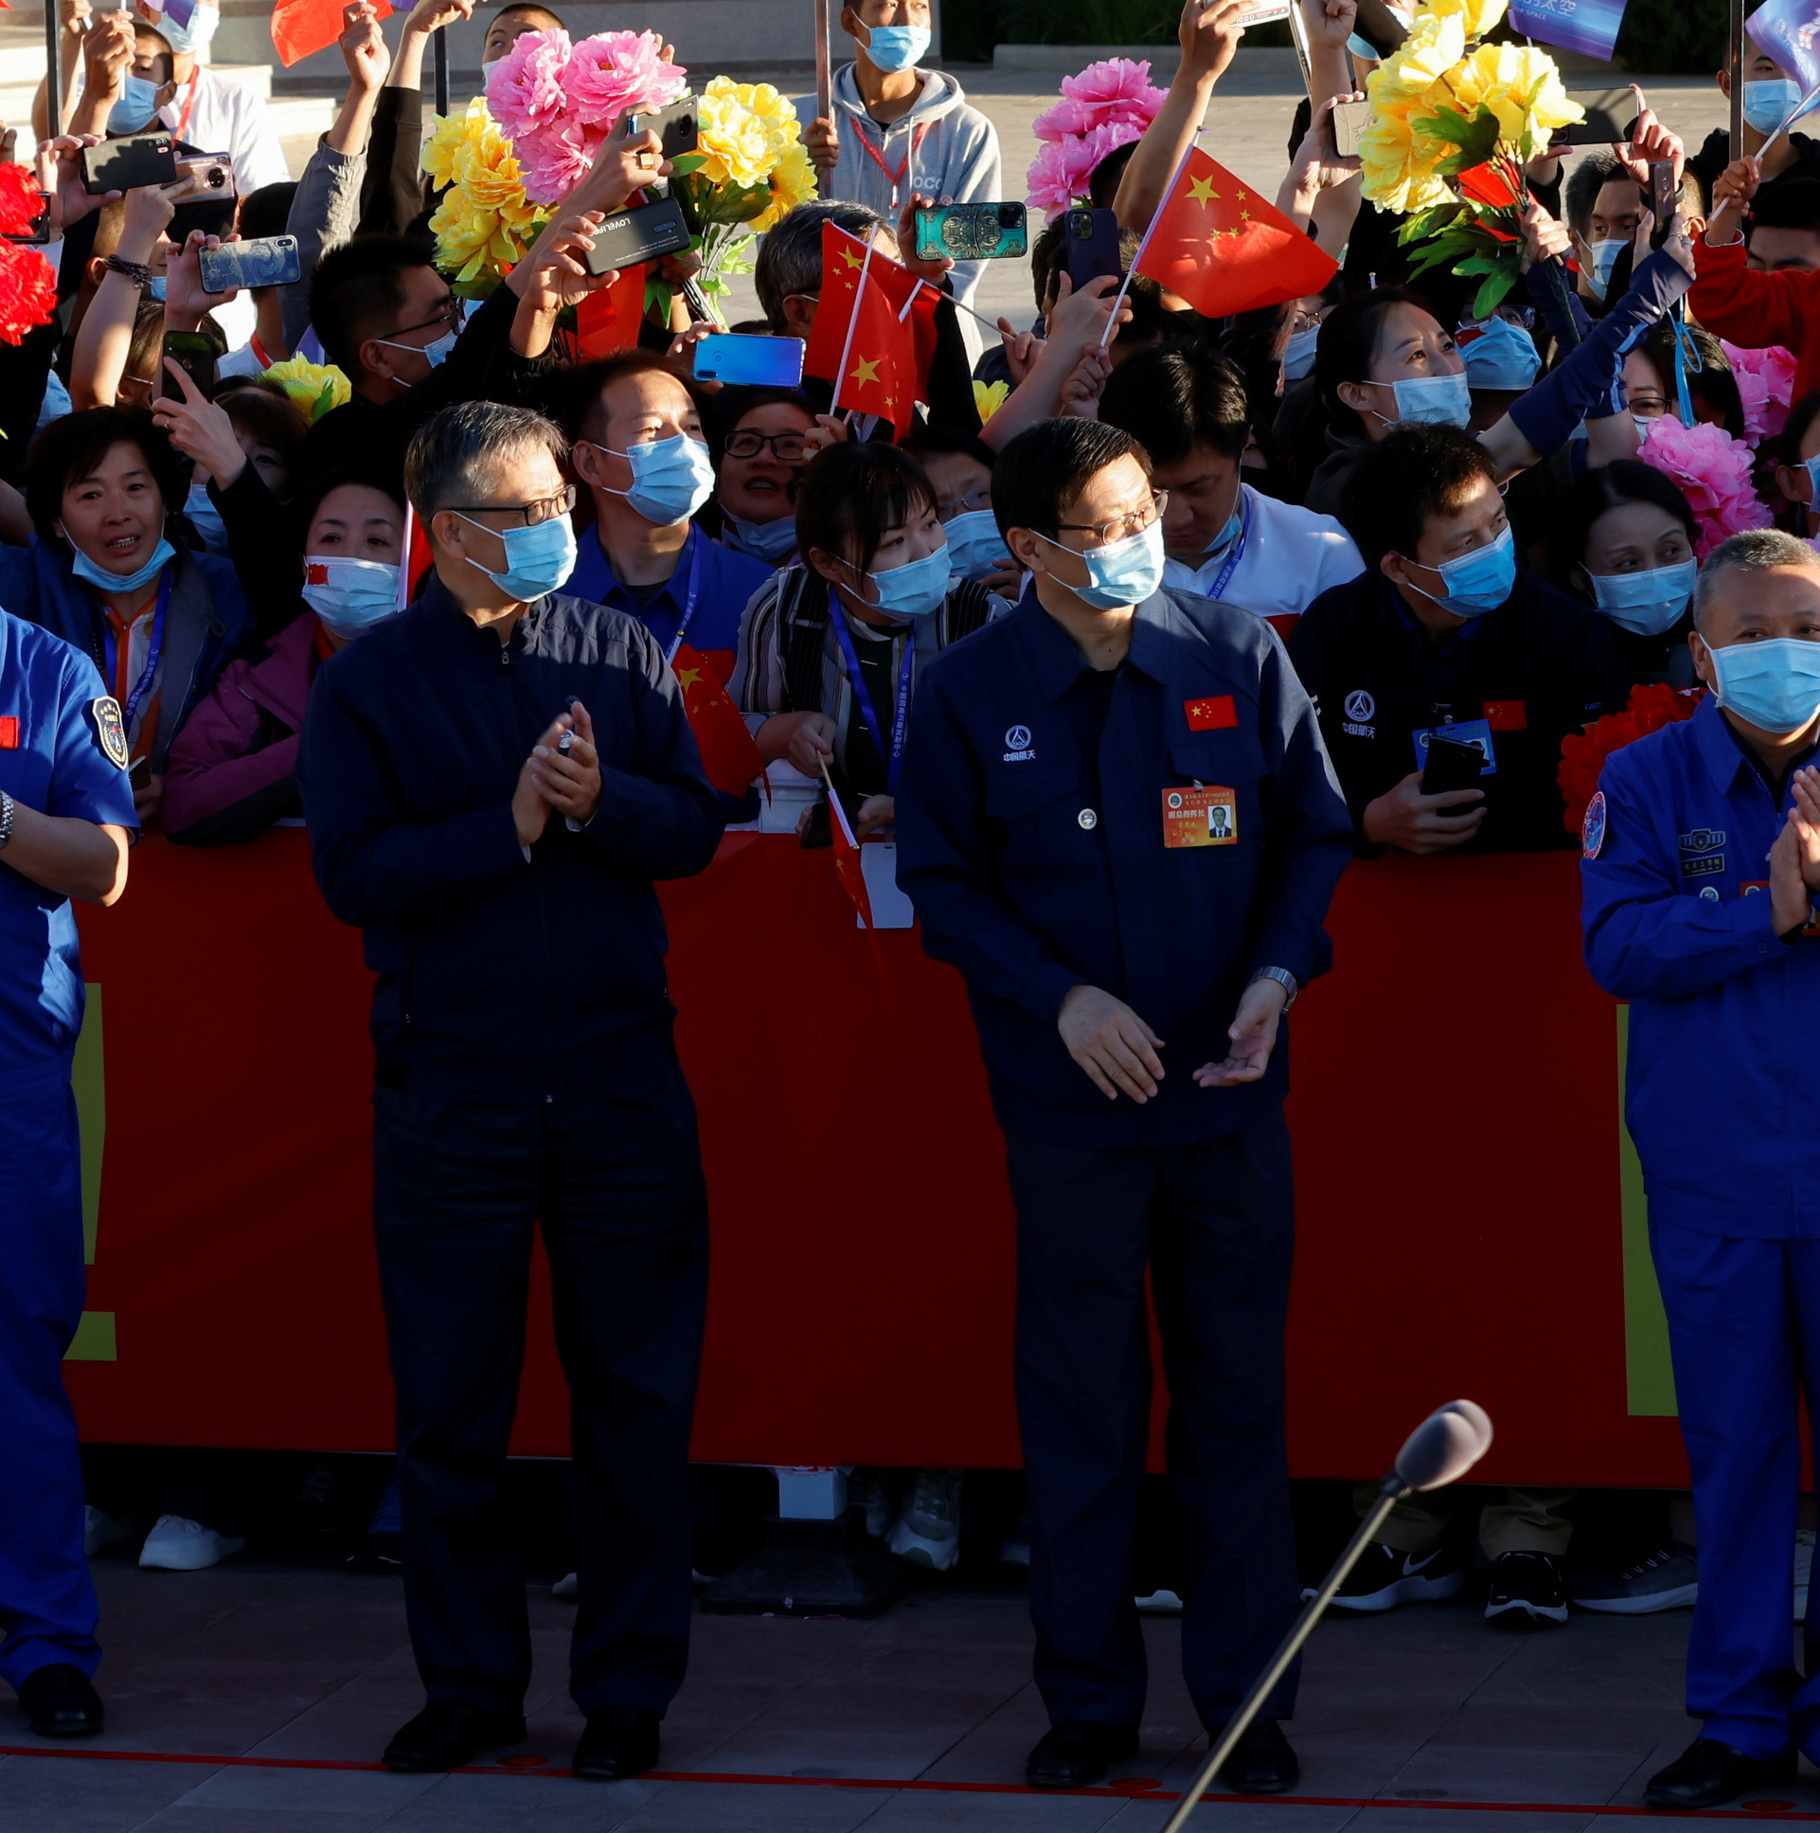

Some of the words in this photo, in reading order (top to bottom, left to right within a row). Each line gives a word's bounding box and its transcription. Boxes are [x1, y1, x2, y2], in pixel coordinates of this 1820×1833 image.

[1342, 722, 1376, 739] 中国航天
[1003, 749, 1036, 762] 中国航天
